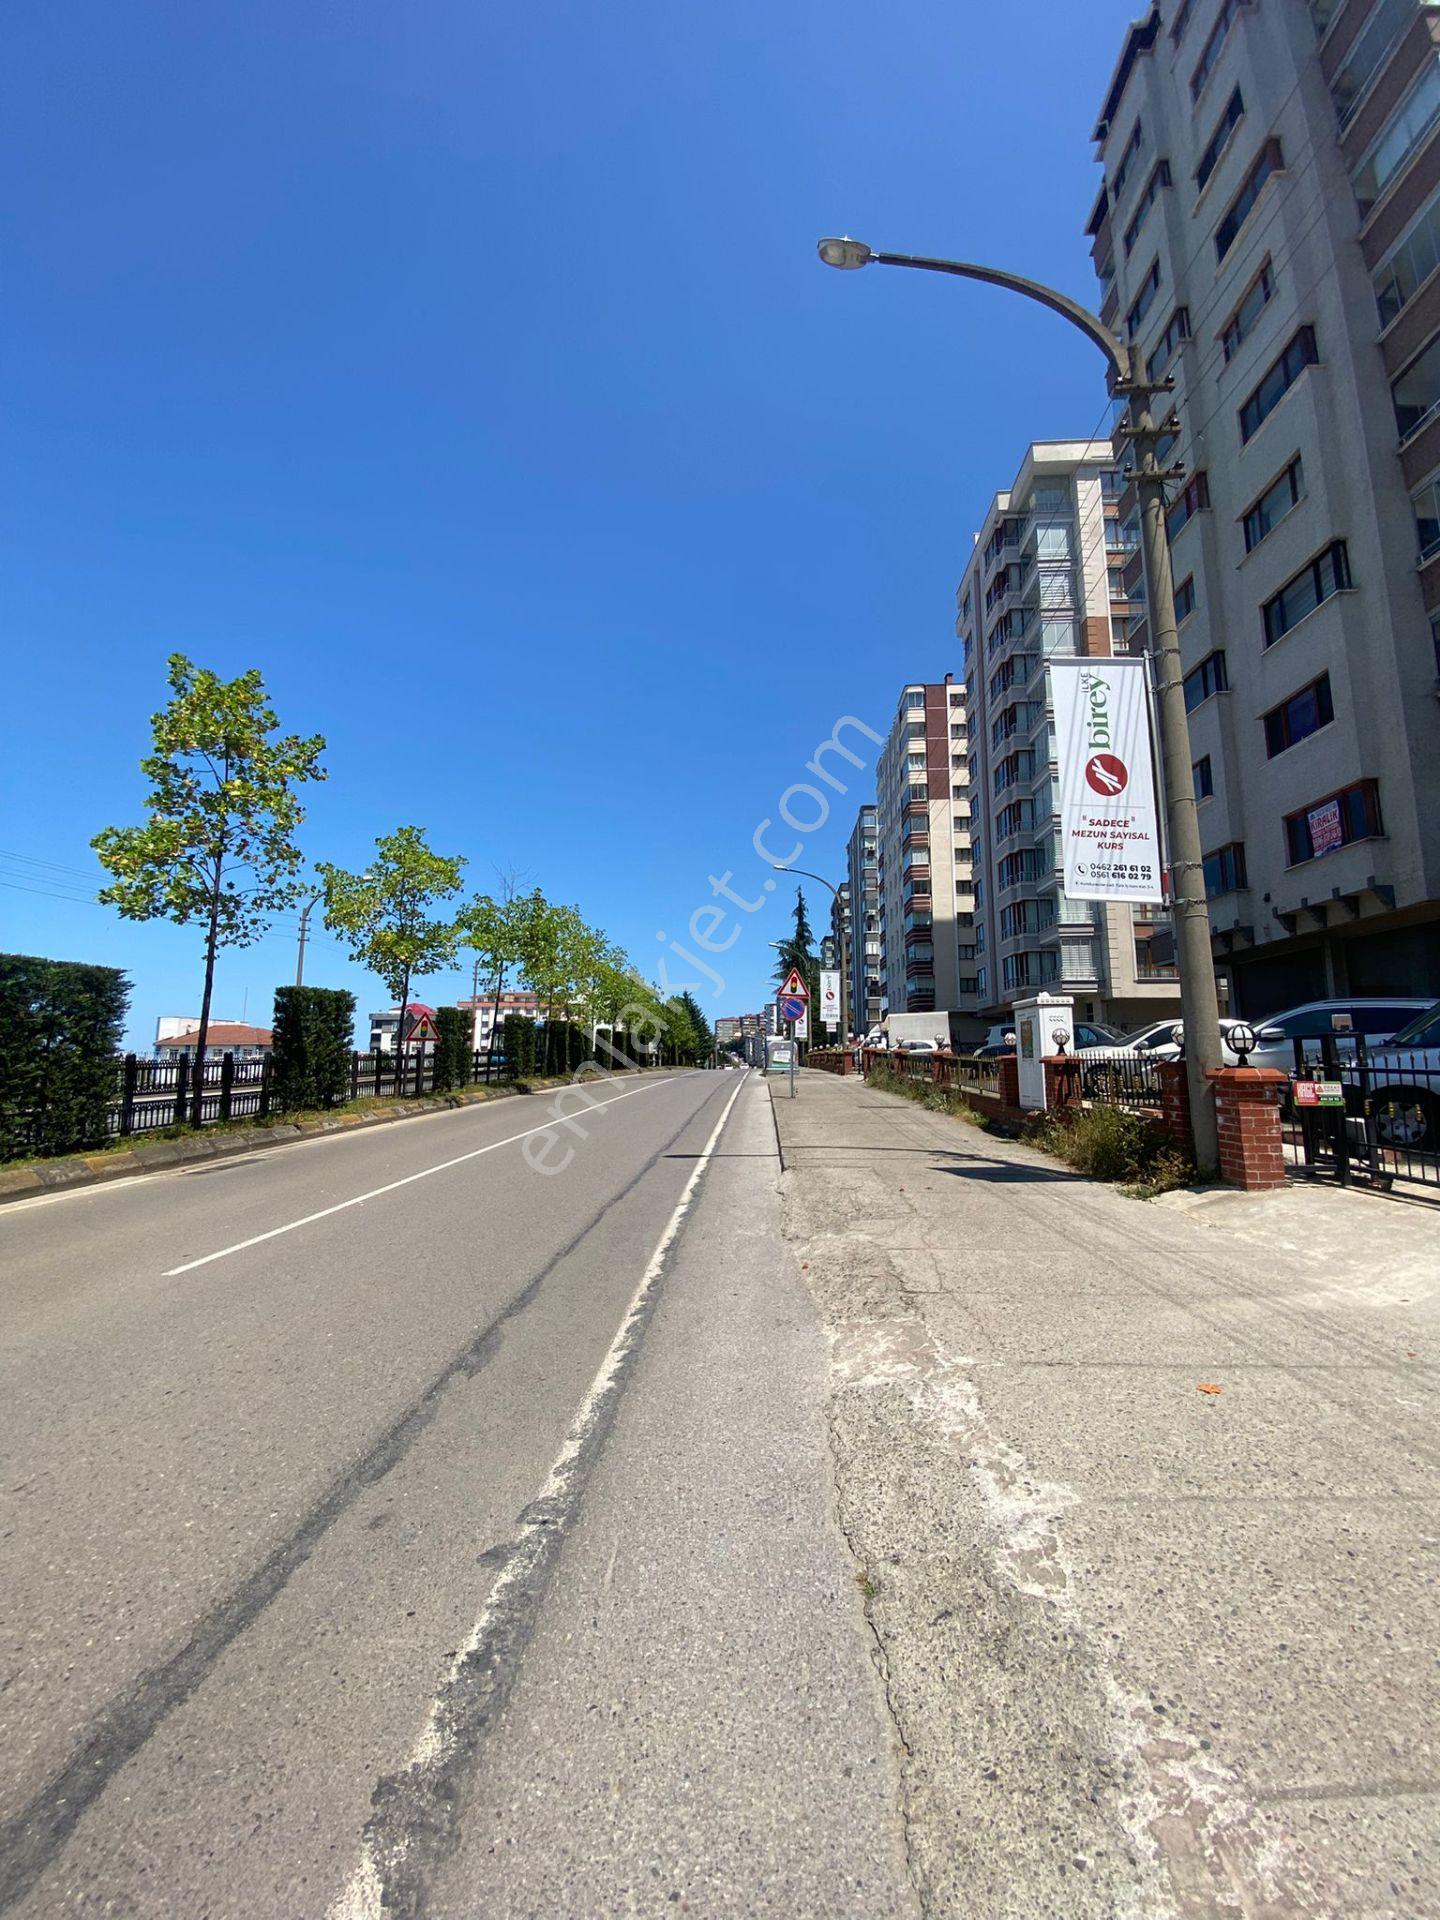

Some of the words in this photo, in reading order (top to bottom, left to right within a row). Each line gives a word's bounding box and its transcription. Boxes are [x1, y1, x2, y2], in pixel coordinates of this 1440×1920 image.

[1086, 673, 1111, 750] birey
[1071, 830, 1107, 838] MEZUN
[1109, 831, 1150, 840] SAYISAL
[1097, 842, 1124, 850] KURS
[1090, 862, 1111, 871] 0462
[1113, 863, 1127, 872] 261
[1090, 871, 1110, 879] 0561
[1111, 871, 1126, 880] 616
